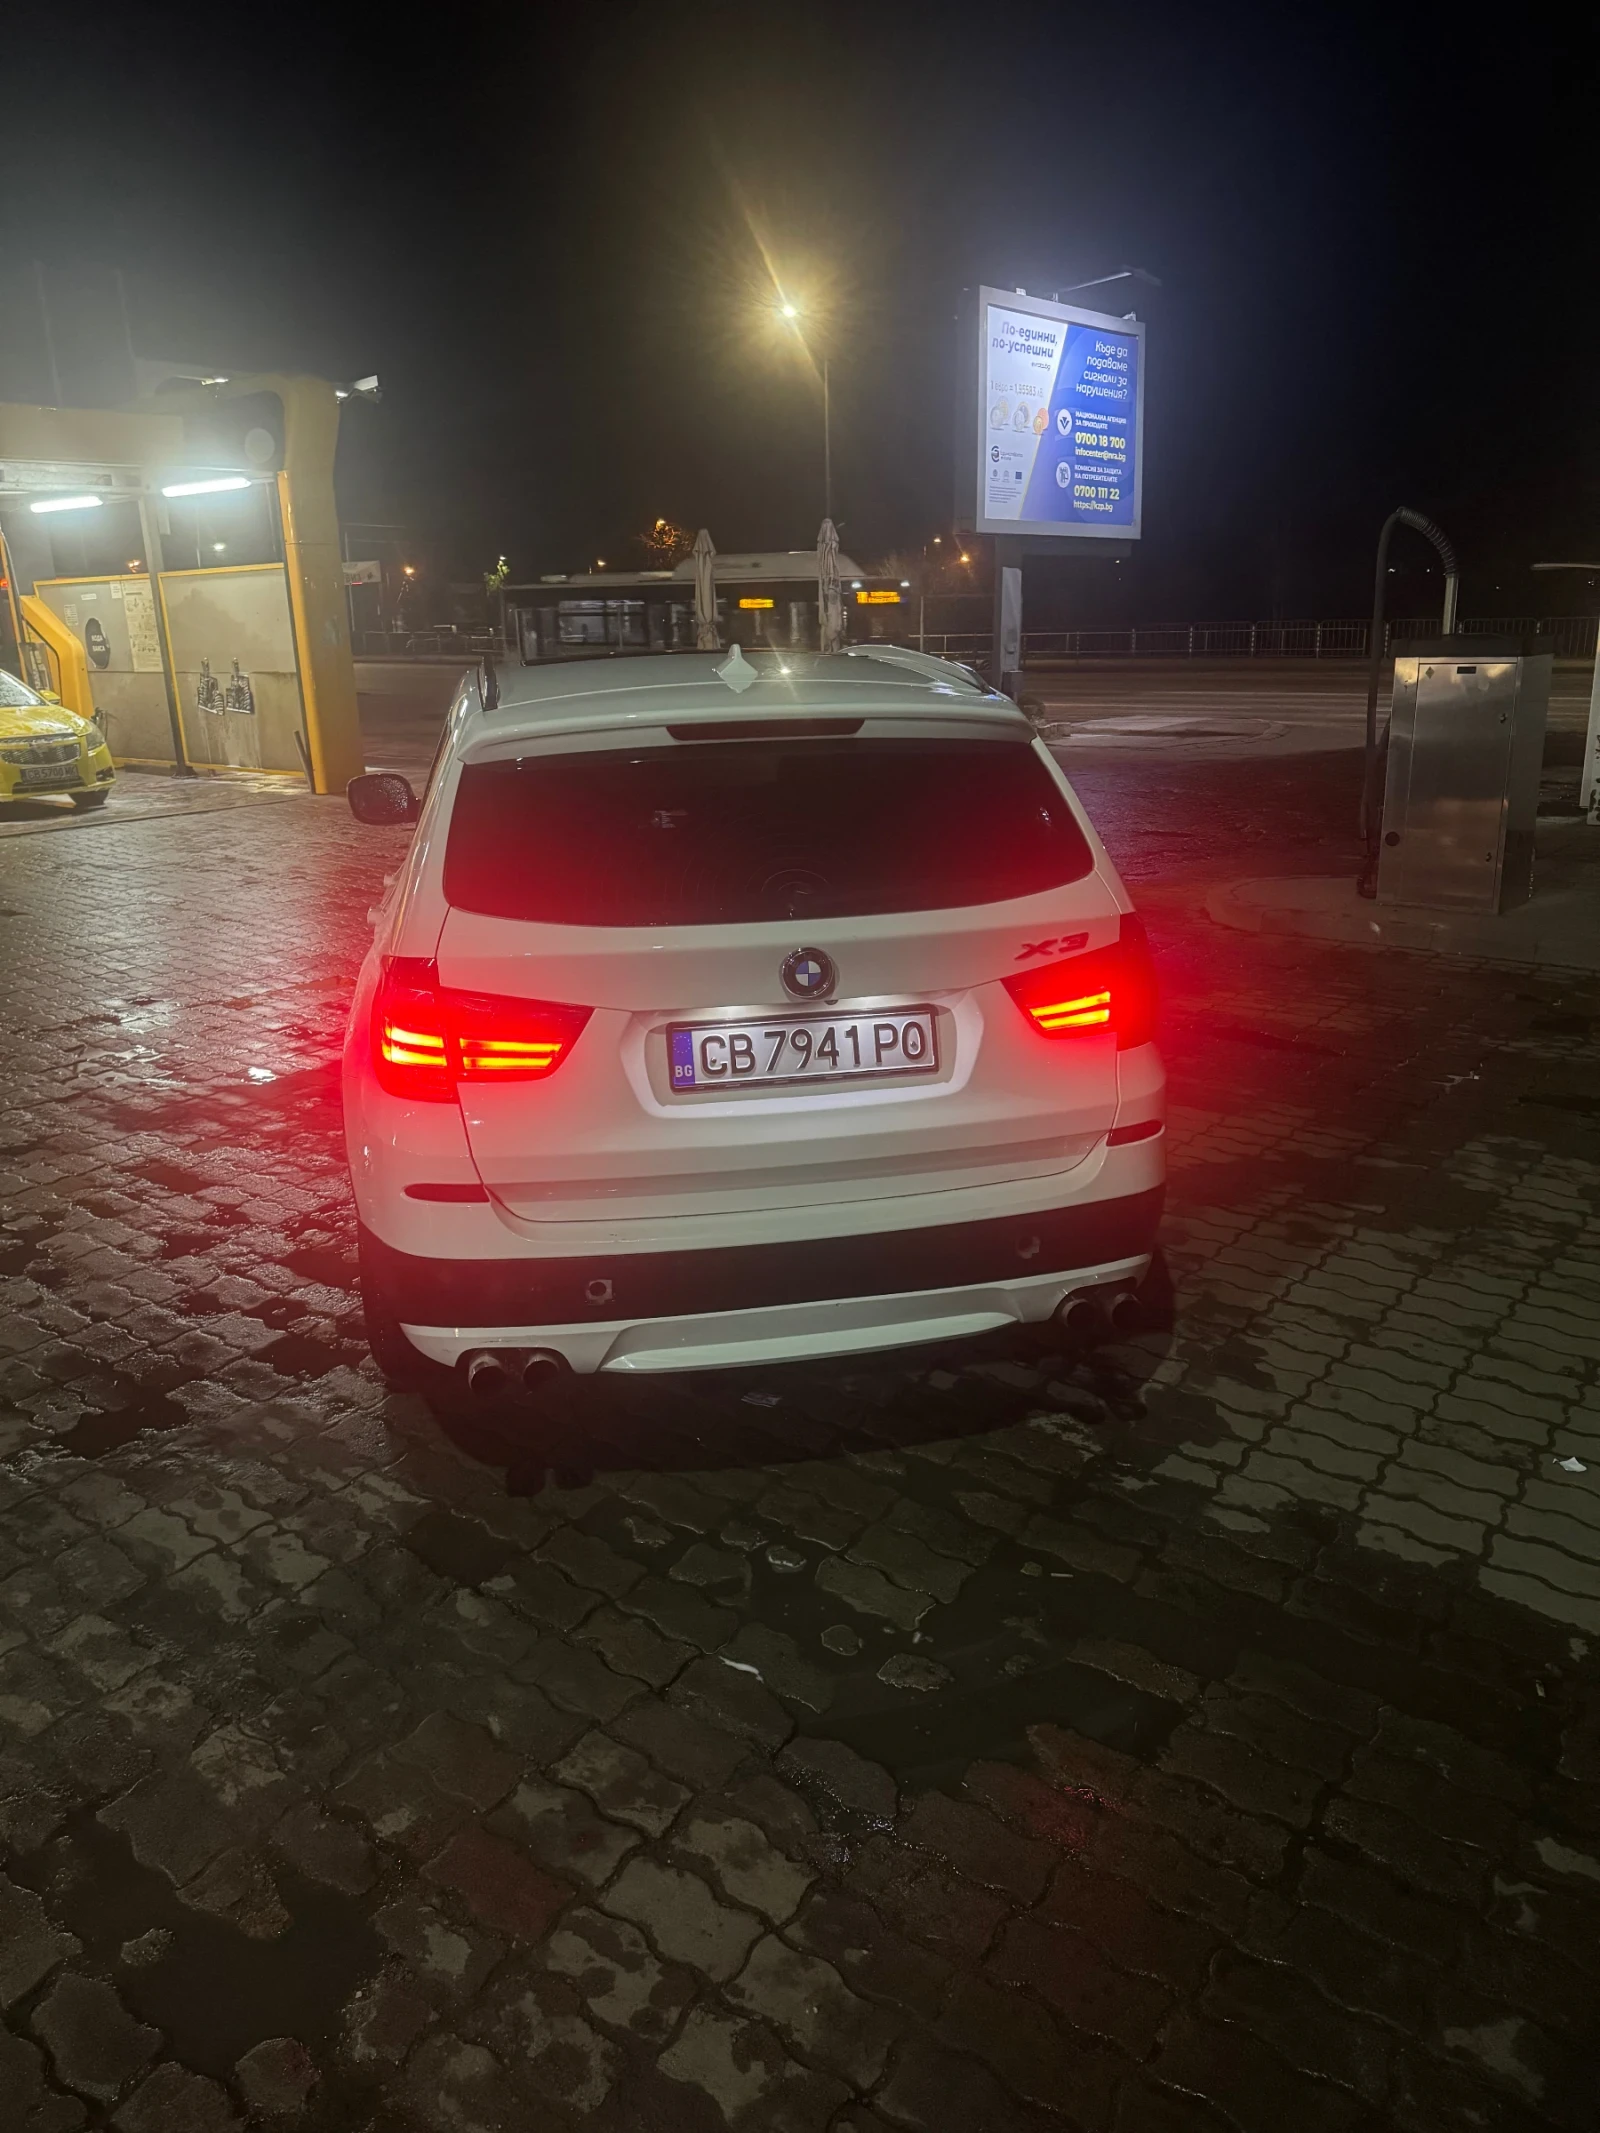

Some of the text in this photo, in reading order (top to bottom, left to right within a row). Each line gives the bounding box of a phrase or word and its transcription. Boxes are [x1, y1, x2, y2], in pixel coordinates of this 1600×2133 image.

[1002, 321, 1058, 346] По-единни,
[992, 337, 1054, 358] по-успешни
[1095, 340, 1128, 358] Къде да
[1086, 356, 1128, 372] подаваме
[1083, 370, 1128, 387] сигнали за
[1076, 383, 1128, 400] нарушения?
[1075, 411, 1127, 424] НАЦИОНАЛНА АГЕНЦИЯ
[1075, 431, 1126, 449] 0700 18 700
[1075, 446, 1126, 462] infocenter@nra.bg
[1074, 464, 1097, 473] КОМИСИЯ
[1103, 467, 1122, 475] ЗАЩИТА
[1082, 473, 1118, 483] ПОТРЕБИТЕЛИТЕ
[1074, 484, 1120, 500] 0700 111 22
[1013, 931, 1089, 961] X3
[700, 1033, 756, 1076] CB
[763, 1024, 861, 1072] 7941
[674, 1064, 693, 1077] BG
